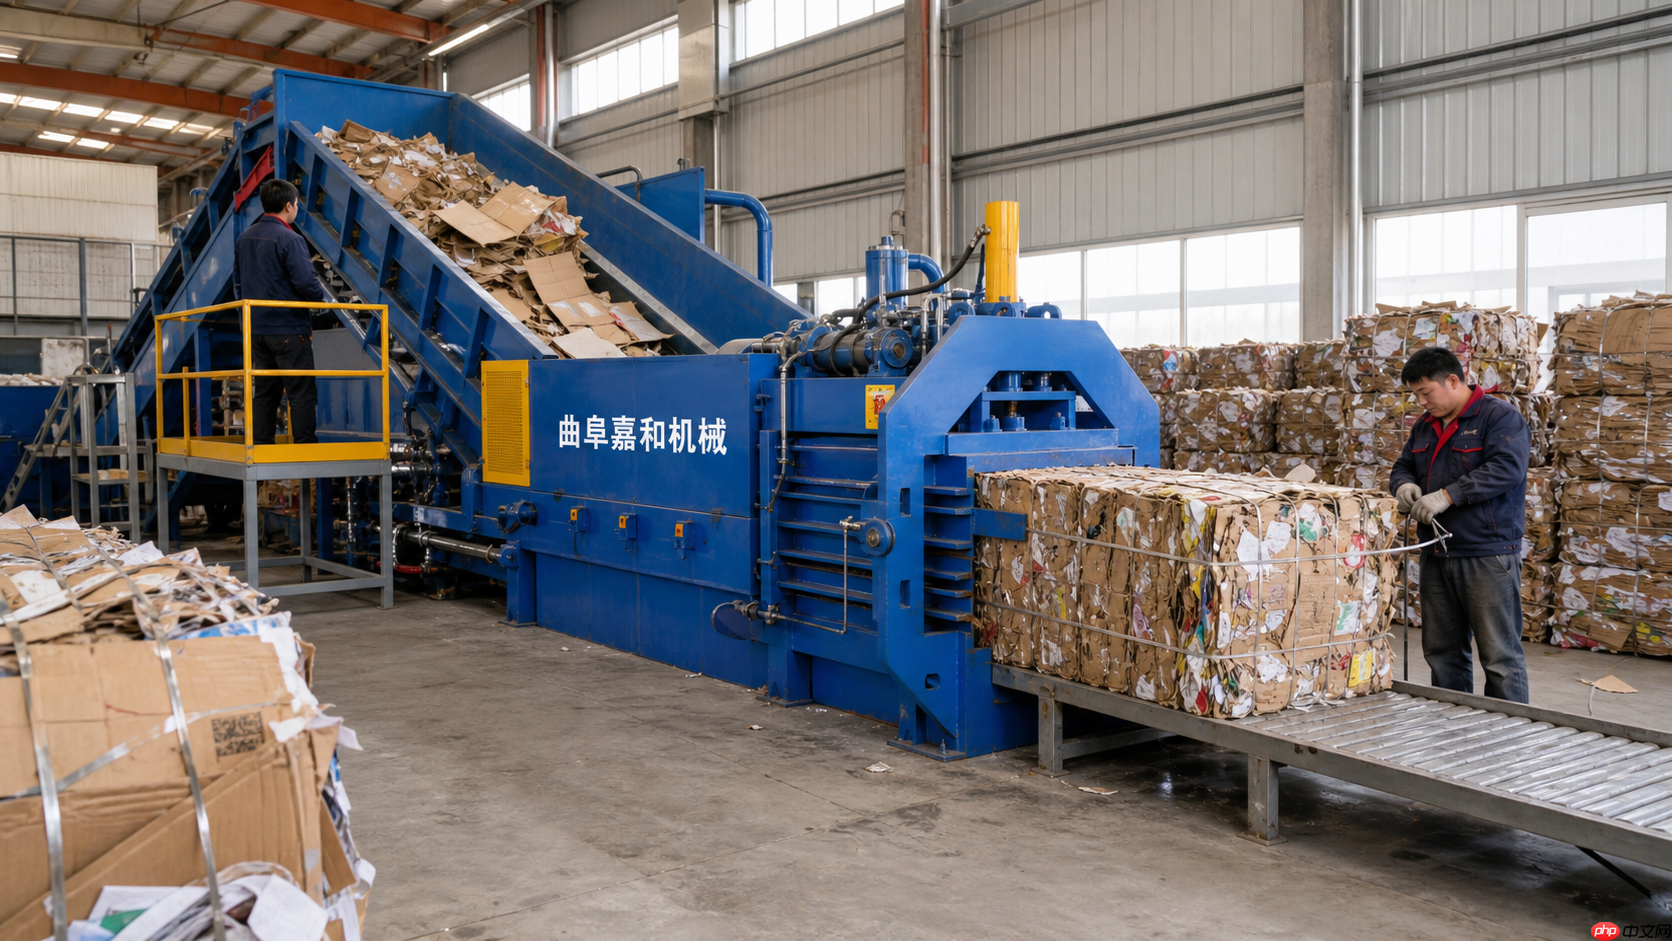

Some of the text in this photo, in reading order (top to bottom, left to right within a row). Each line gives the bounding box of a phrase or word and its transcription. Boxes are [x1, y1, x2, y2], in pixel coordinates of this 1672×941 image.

[559, 414, 728, 456] 曲阜嘉和机械
